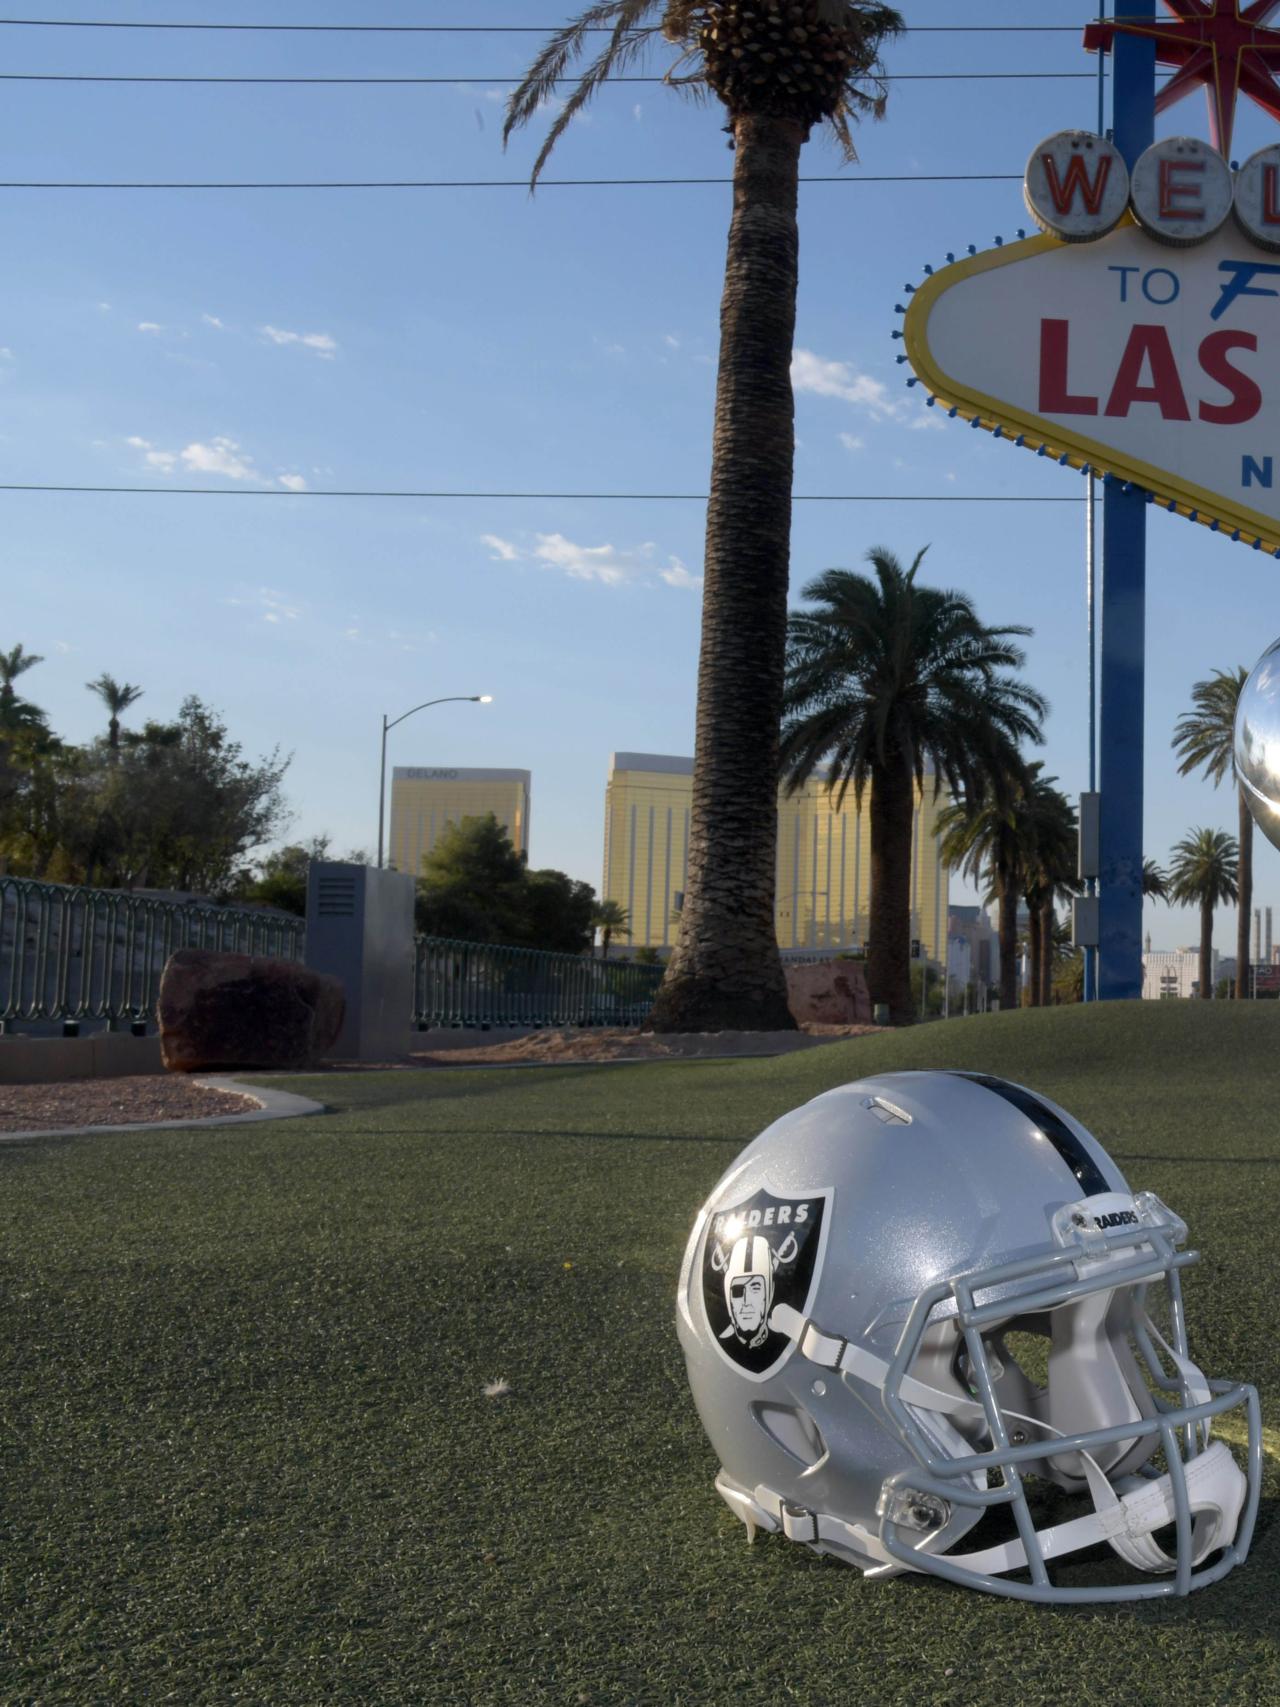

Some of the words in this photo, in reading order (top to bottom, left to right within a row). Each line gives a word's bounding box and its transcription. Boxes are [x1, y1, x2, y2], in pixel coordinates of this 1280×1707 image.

[1108, 265, 1180, 304] TO
[1038, 318, 1263, 425] LAS
[407, 768, 458, 779] DELANO
[1094, 1210, 1139, 1229] RAIDERS
